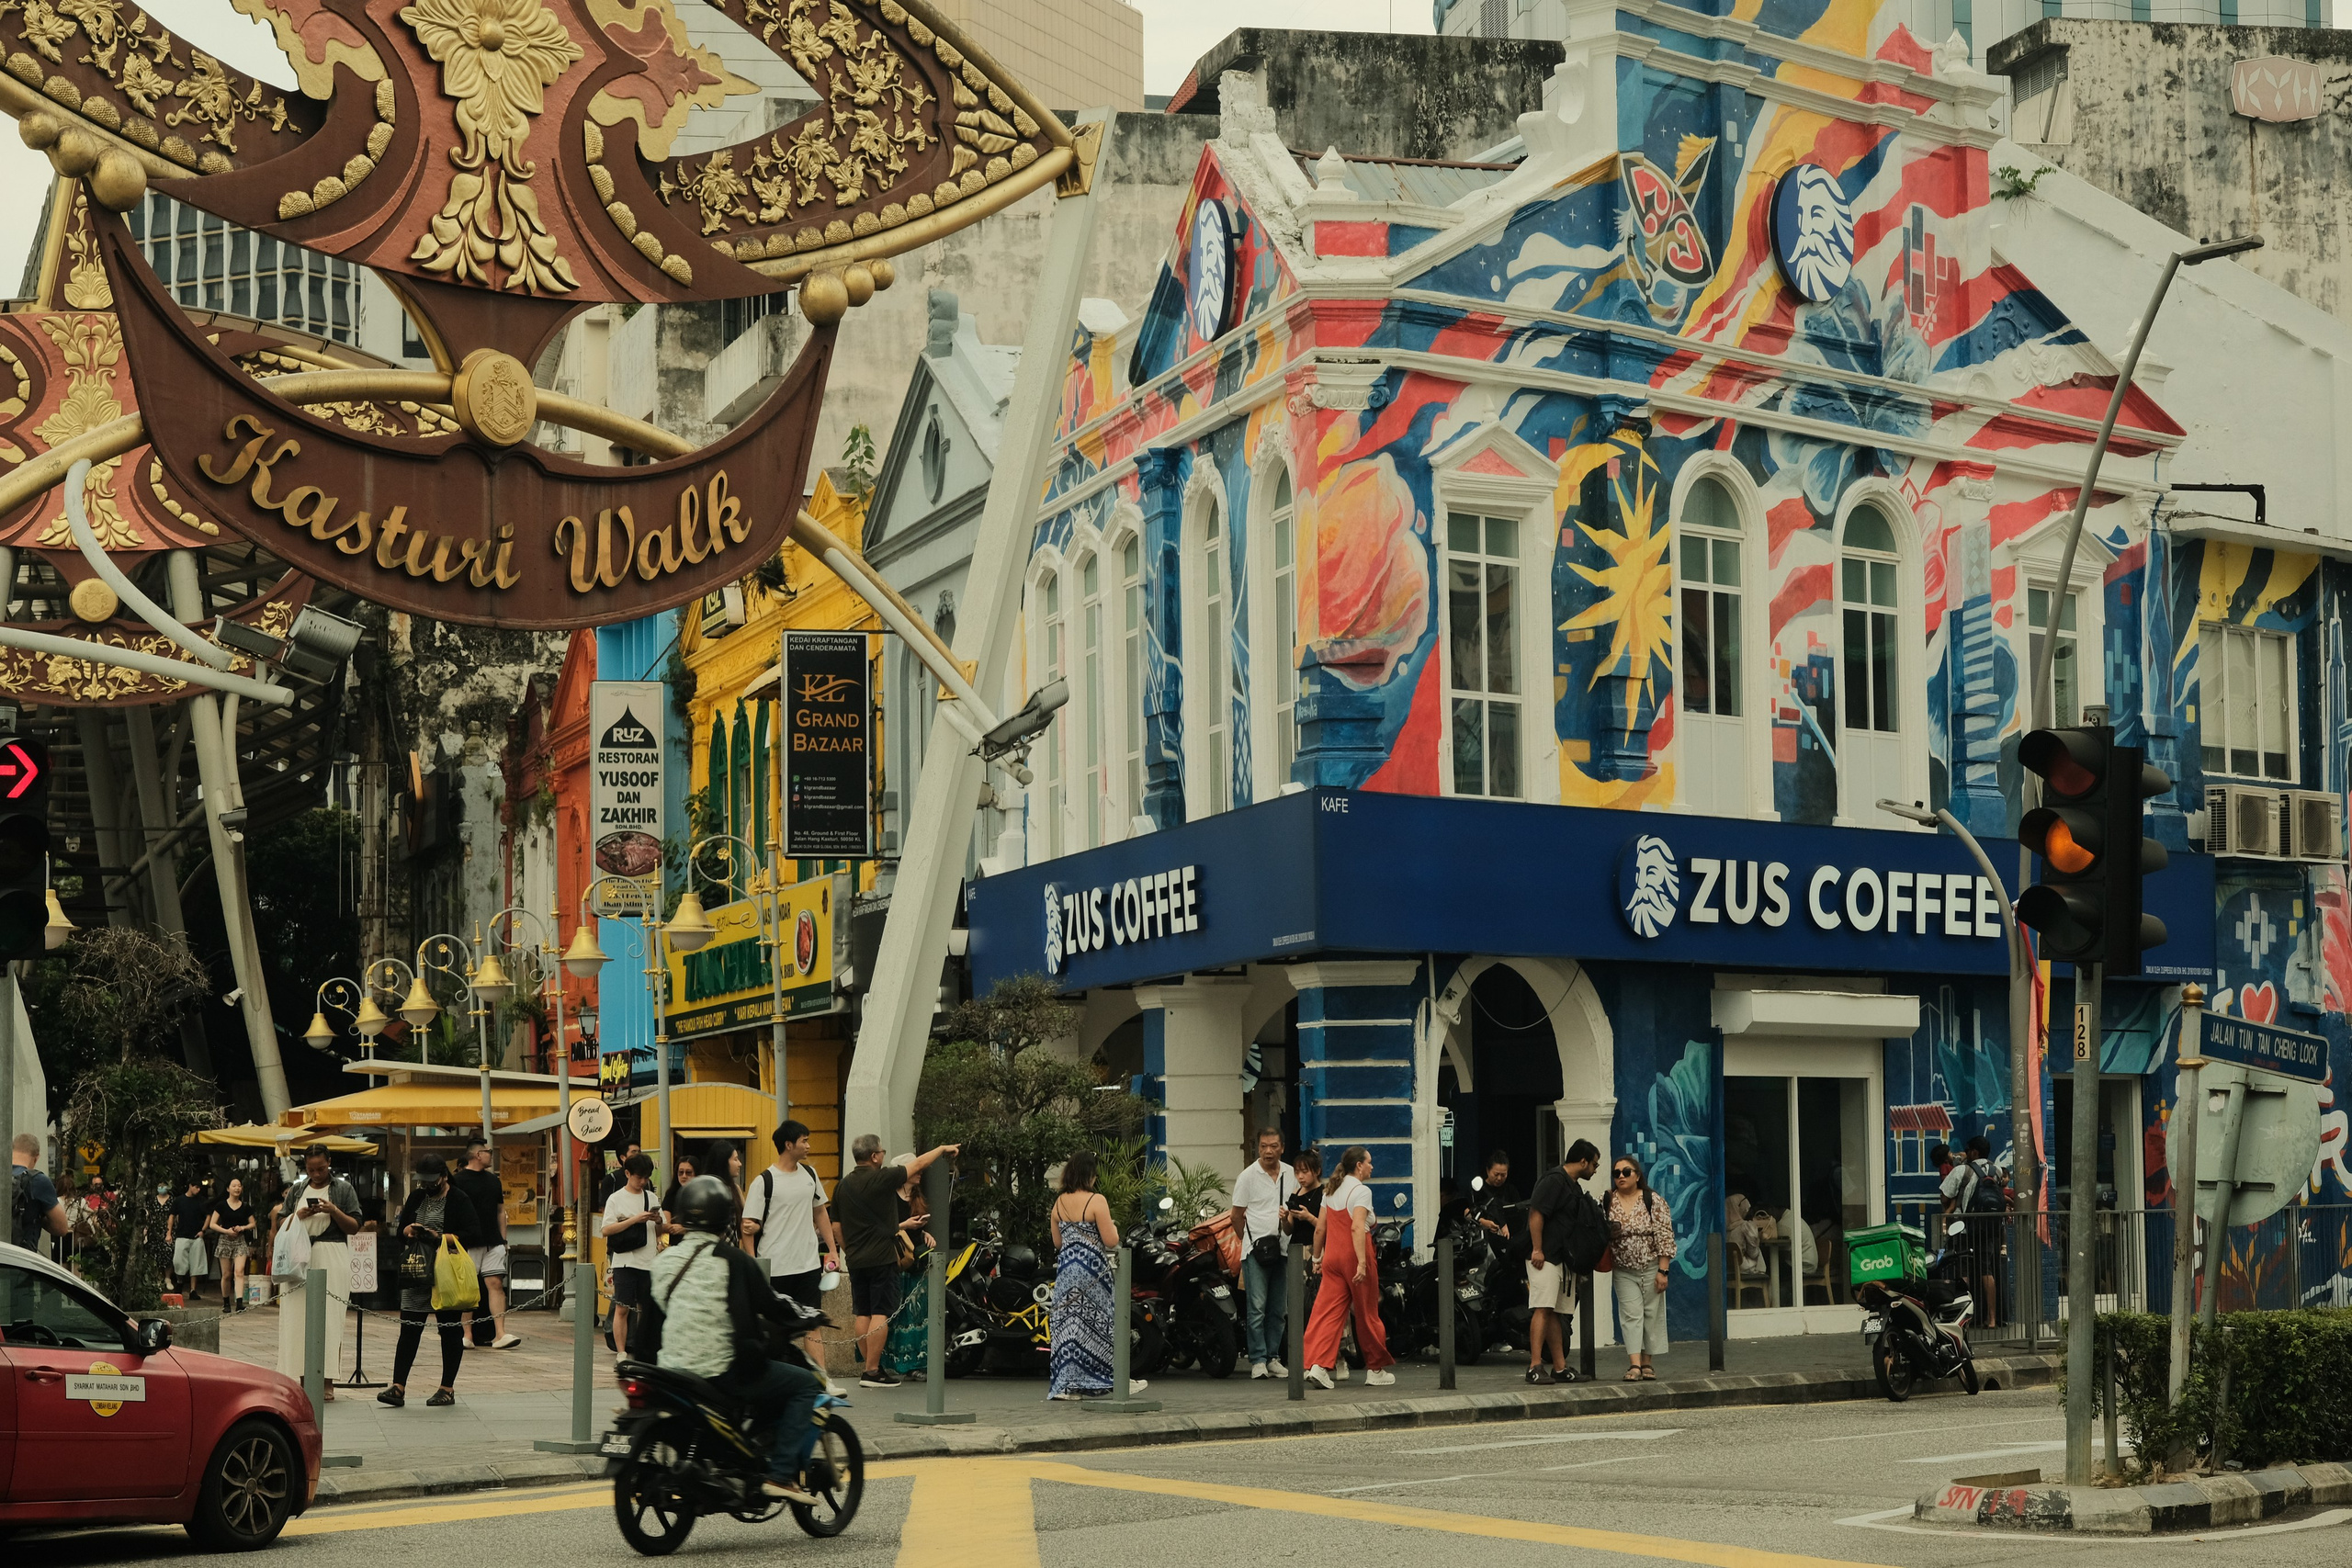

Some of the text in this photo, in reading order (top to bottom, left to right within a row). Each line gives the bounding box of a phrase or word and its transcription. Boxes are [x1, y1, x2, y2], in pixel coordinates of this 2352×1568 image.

[198, 413, 752, 593] Kasturi Walk
[802, 674, 845, 703] KL
[796, 709, 860, 728] GRAND
[794, 733, 864, 751] BAZAAR
[598, 751, 659, 764] RESTORAN
[599, 772, 659, 787] YUSOOF
[617, 791, 640, 804] DAN
[1321, 796, 1349, 813] KAFE
[601, 808, 658, 823] ZAKHIR
[1690, 858, 2001, 939] ZUS COFFEE
[1062, 865, 1198, 955] ZUS COFFEE
[2077, 1007, 2086, 1057] 128
[2211, 1022, 2234, 1046] JALAN
[2239, 1029, 2253, 1051] TUN
[2258, 1032, 2271, 1055] TAN
[2274, 1037, 2297, 1061] CHENG
[2300, 1043, 2319, 1066] LOCK
[577, 1105, 601, 1117] Bread
[581, 1124, 603, 1136] Juice
[1860, 1255, 1893, 1271] Grab
[1939, 1486, 2027, 1516] STN 19
